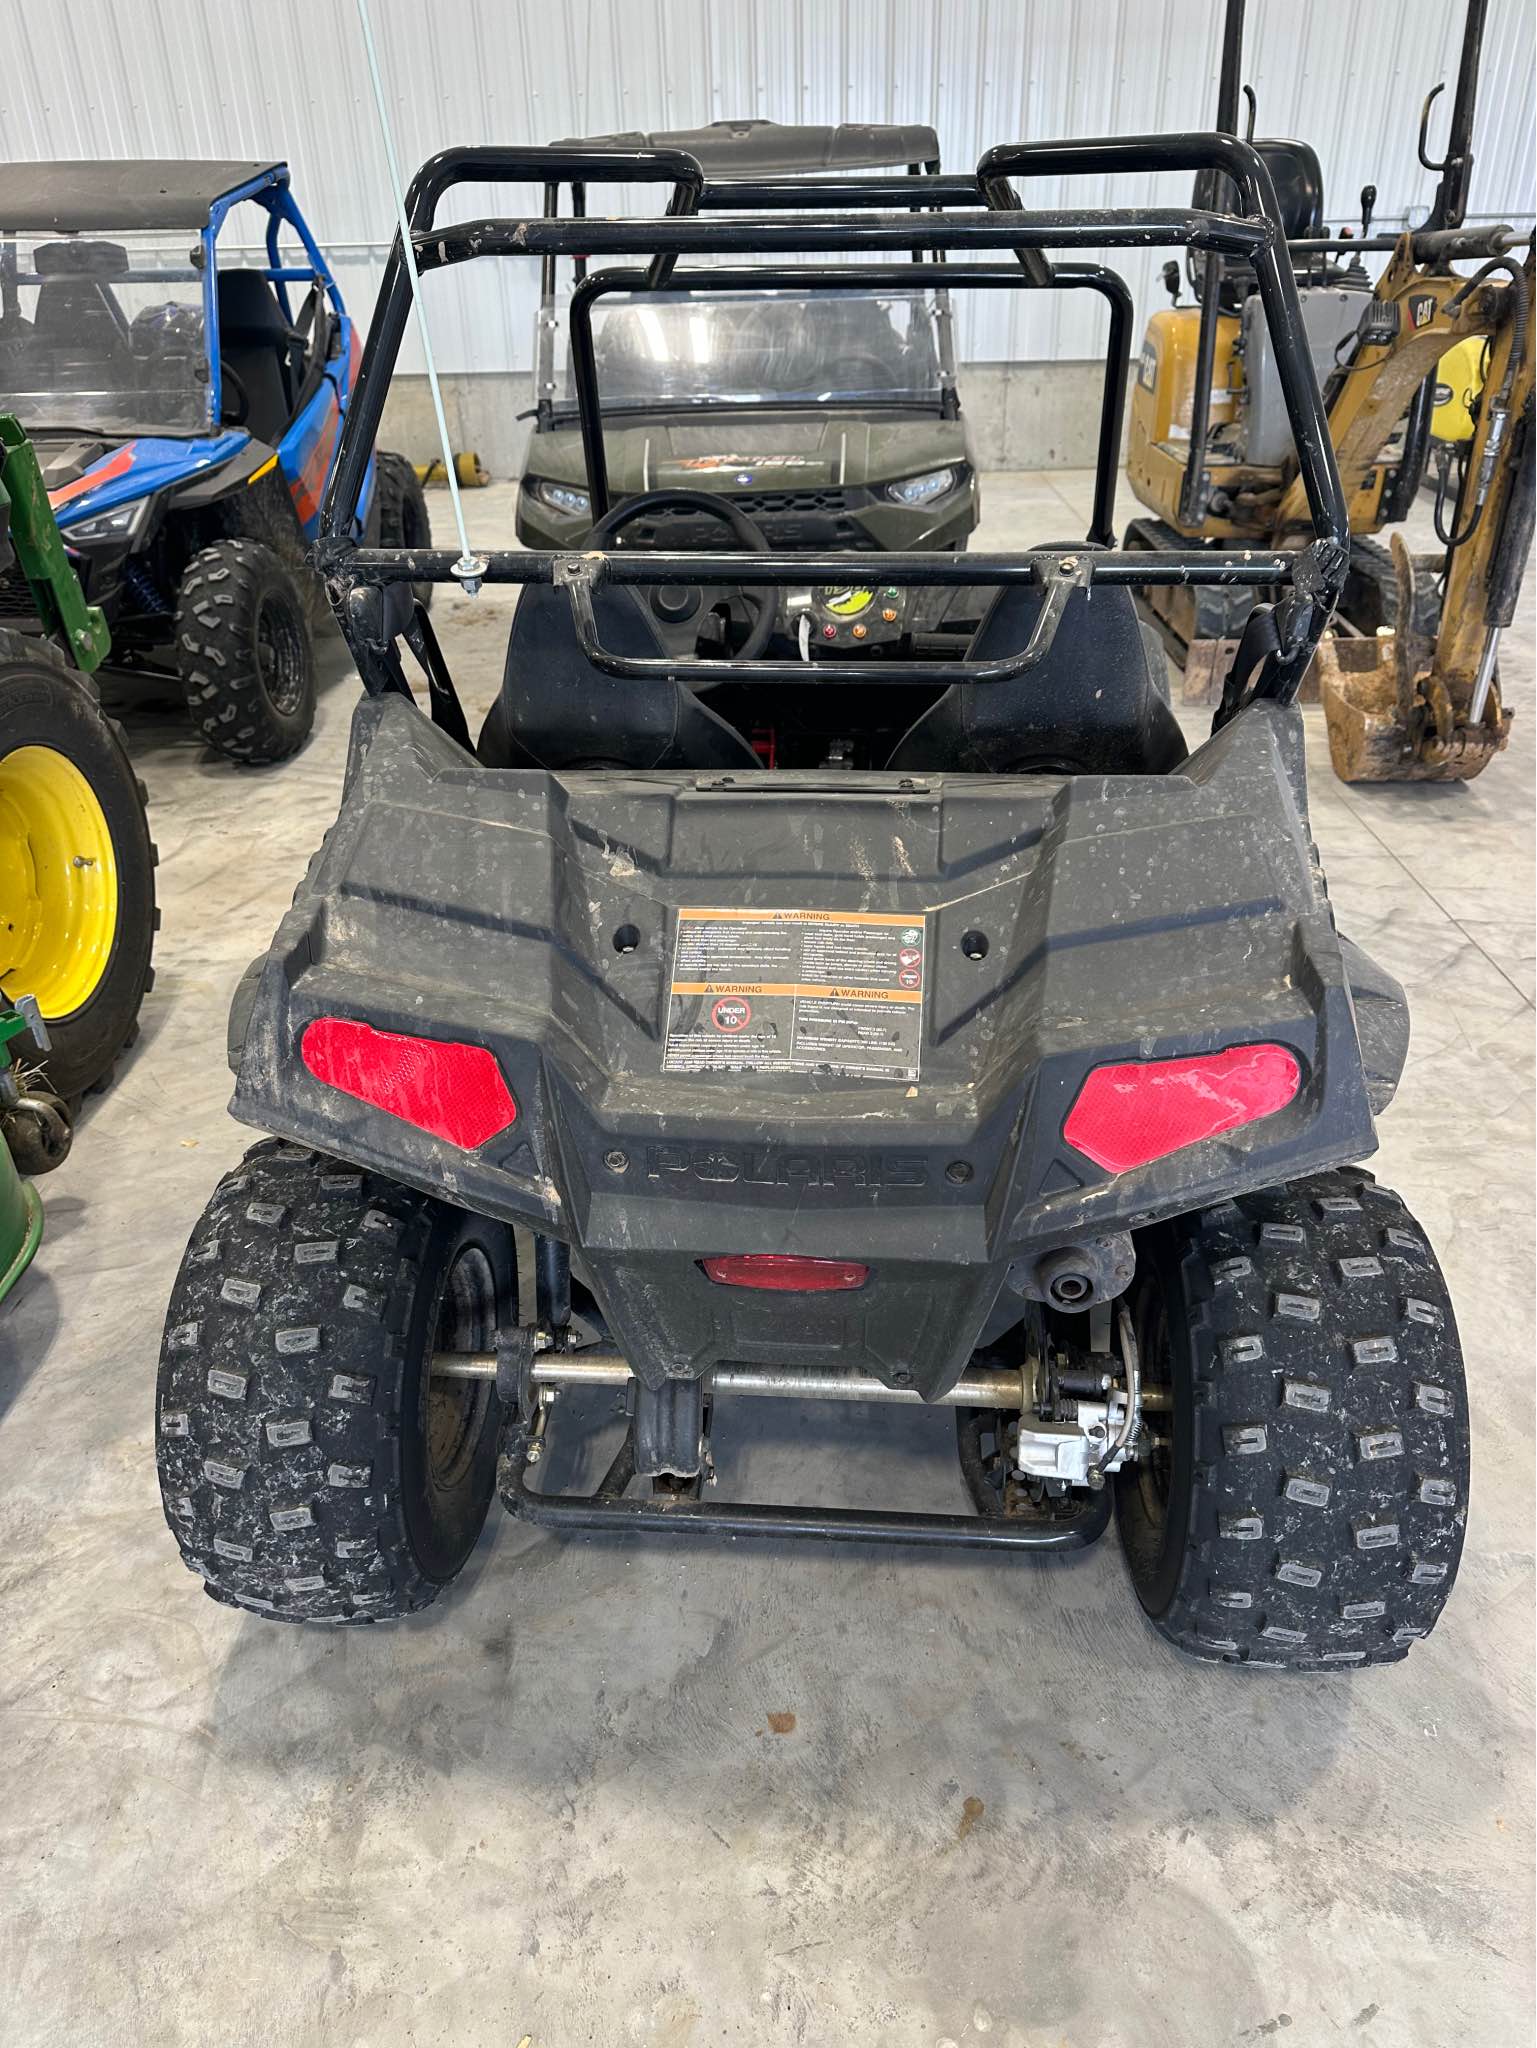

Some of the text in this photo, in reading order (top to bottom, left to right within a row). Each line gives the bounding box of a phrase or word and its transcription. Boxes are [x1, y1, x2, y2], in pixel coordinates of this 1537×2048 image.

[1416, 298, 1433, 327] CAT
[784, 912, 830, 921] WARNING
[716, 985, 762, 993] WARNING
[841, 989, 889, 999] WARNING
[725, 1016, 737, 1024] 10
[647, 1147, 928, 1187] POLARIS
